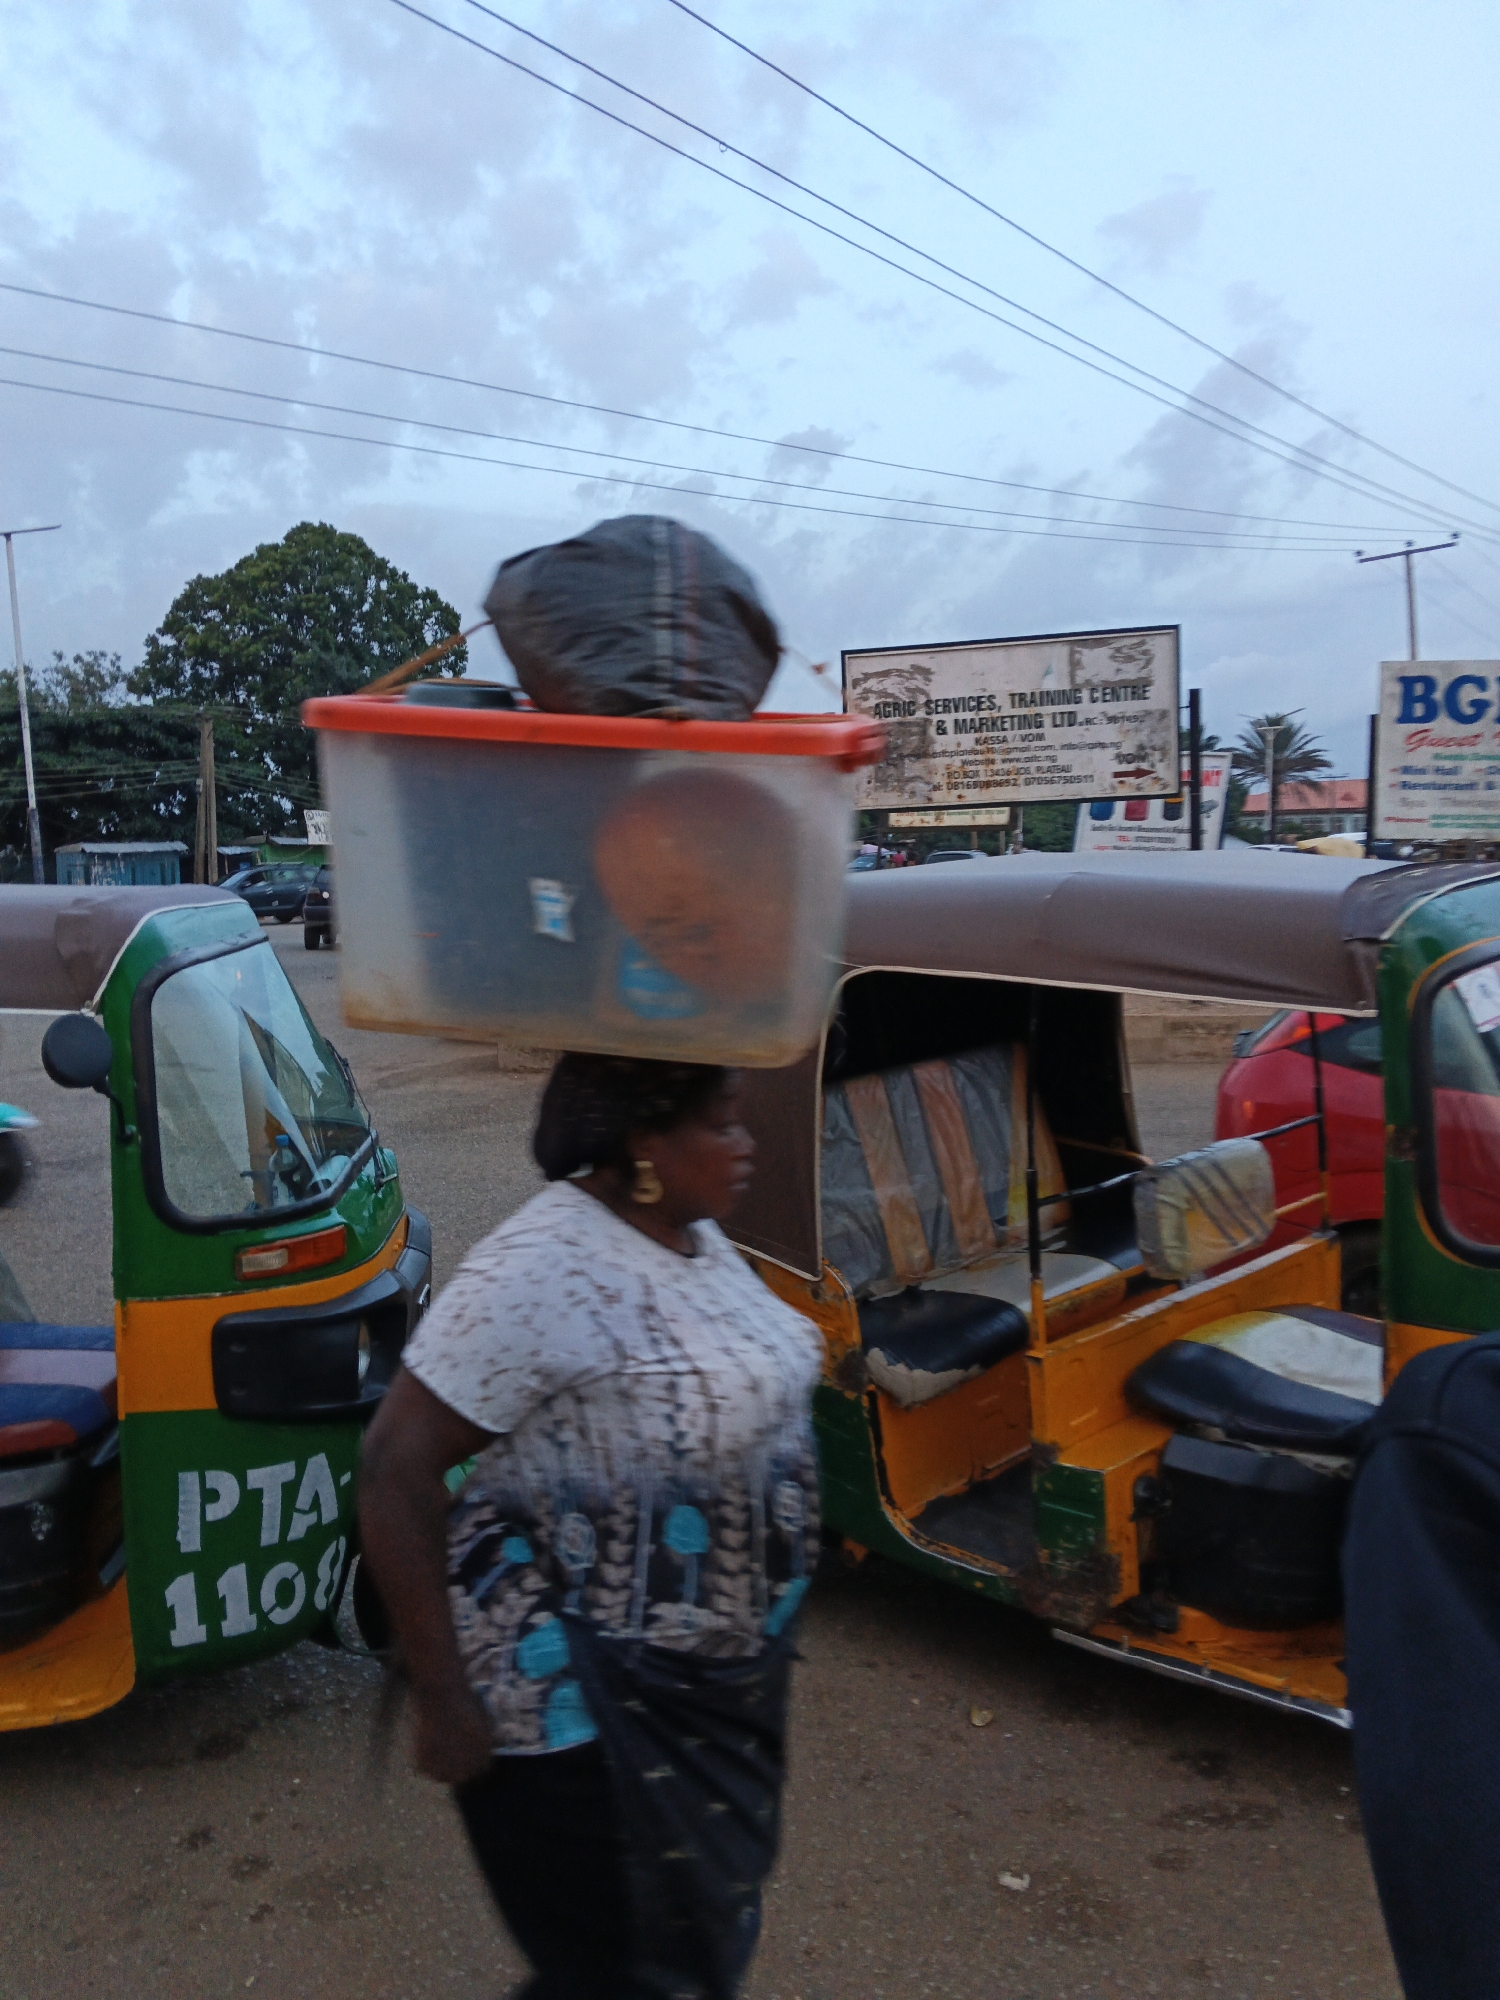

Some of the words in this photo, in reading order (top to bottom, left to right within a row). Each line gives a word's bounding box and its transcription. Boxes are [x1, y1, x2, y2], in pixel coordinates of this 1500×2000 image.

[874, 700, 917, 719] AGRIC
[924, 695, 1002, 716] SERVICES,
[1008, 688, 1083, 709] TRAINING
[1089, 684, 1151, 704] CENTRE
[936, 719, 948, 736] &
[954, 712, 1045, 735] MARKETING
[974, 735, 1010, 747] KASSA
[1020, 733, 1046, 743] VOM
[164, 1535, 346, 1648] 1108
